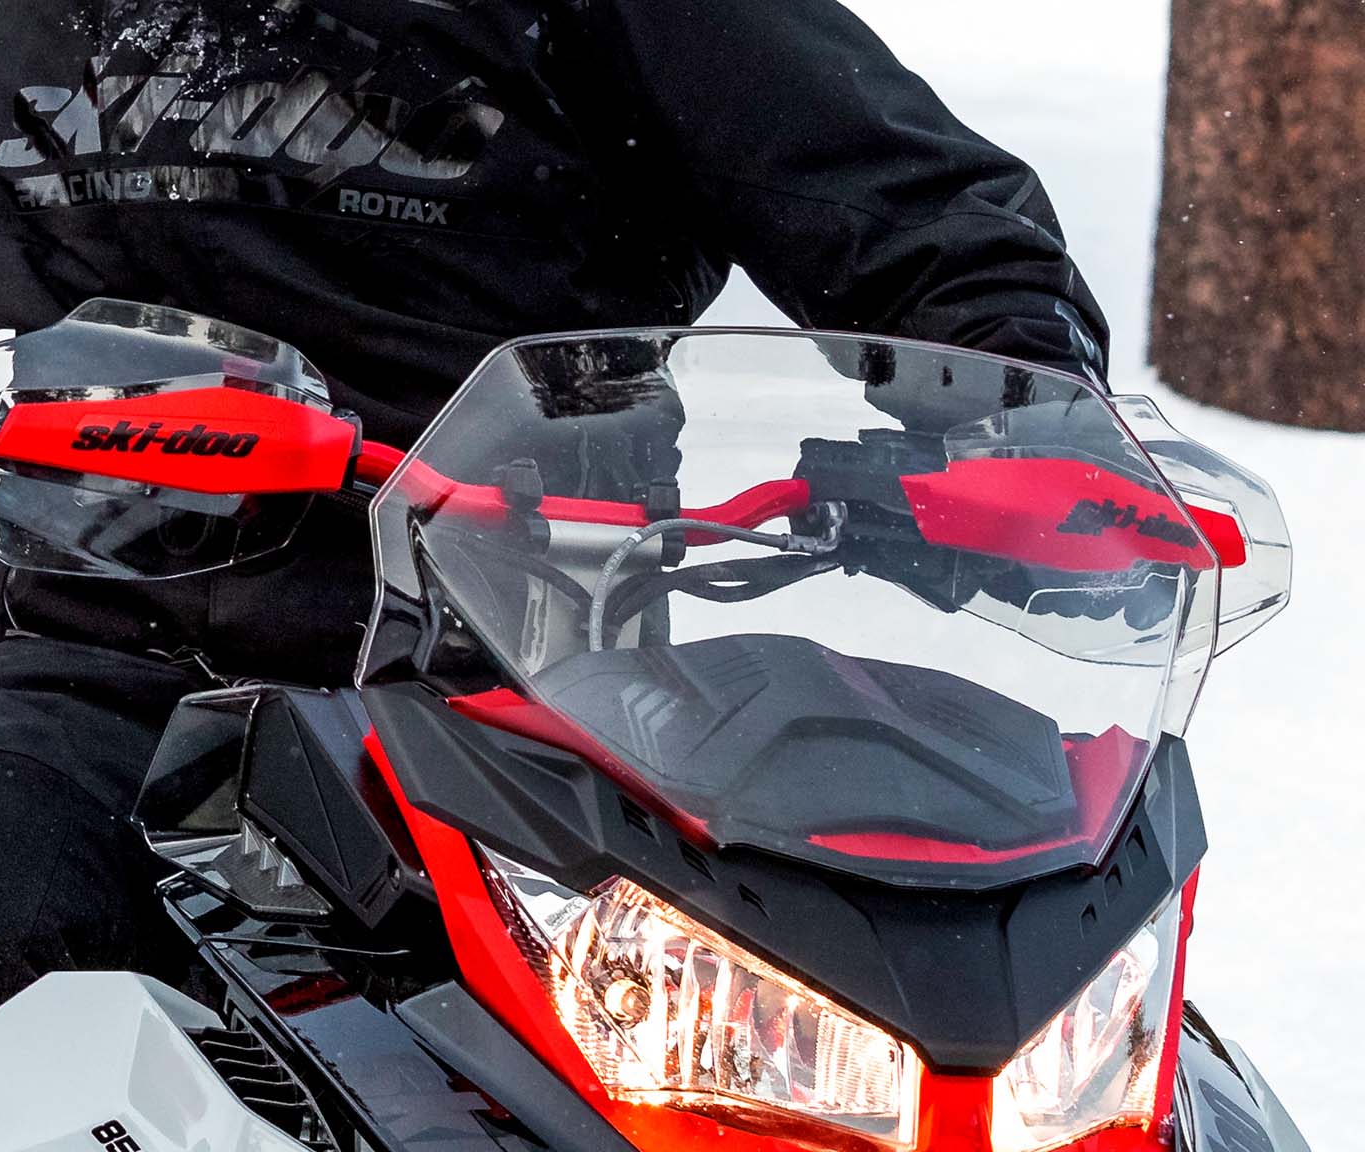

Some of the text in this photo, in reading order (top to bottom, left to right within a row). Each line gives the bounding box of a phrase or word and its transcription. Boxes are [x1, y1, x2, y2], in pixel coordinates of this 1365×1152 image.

[15, 170, 153, 209] RACING
[338, 188, 450, 226] ROTAX
[71, 421, 259, 458] ski-doo
